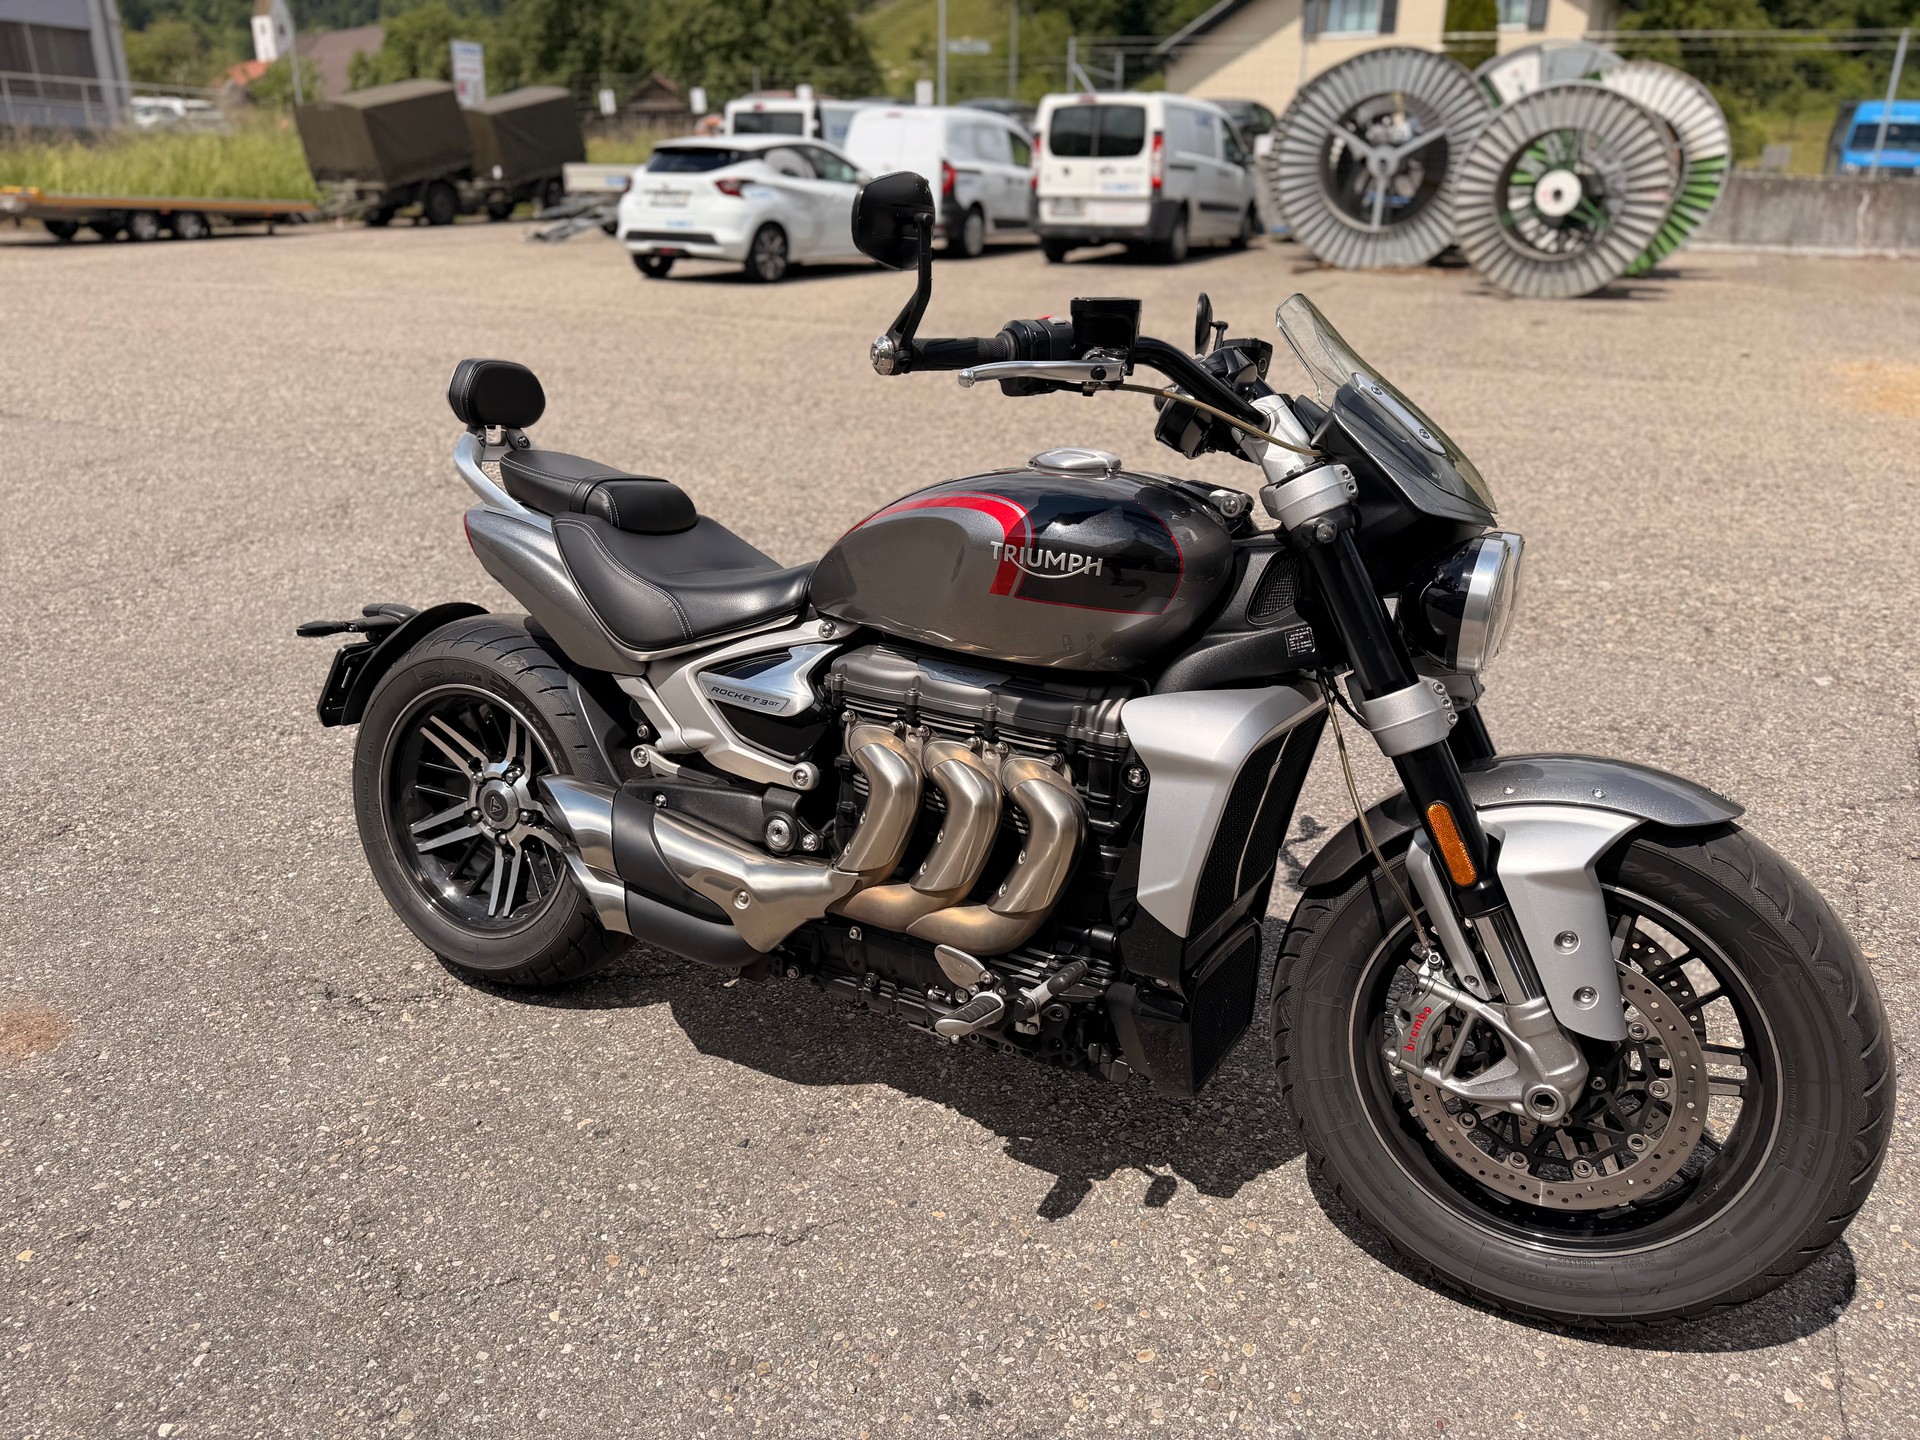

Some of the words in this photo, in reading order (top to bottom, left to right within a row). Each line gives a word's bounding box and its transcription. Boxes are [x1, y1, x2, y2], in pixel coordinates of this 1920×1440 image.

[990, 540, 1103, 579] TRIUMPH
[1618, 860, 1733, 921] ROME
[1403, 1006, 1432, 1052] brembo
